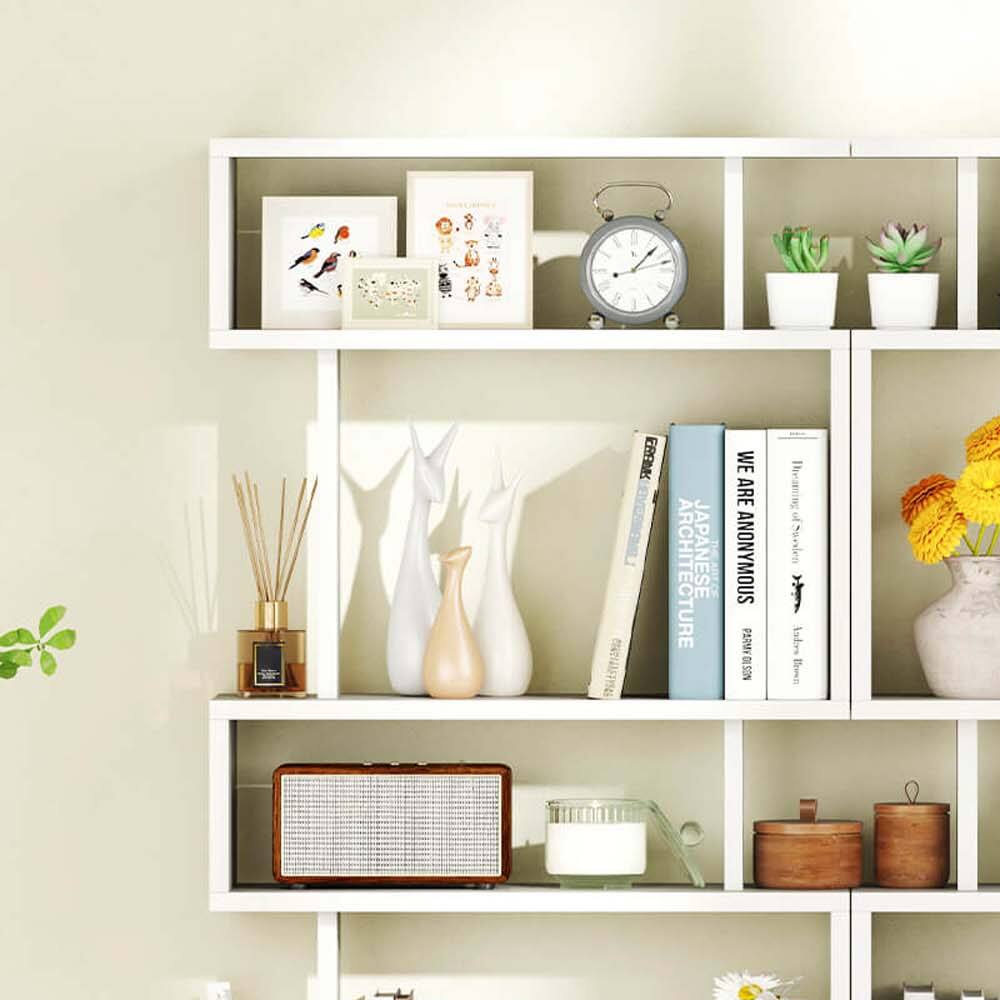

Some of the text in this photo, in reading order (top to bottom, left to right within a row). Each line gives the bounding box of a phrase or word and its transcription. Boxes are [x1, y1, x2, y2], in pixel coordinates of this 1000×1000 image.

[694, 499, 709, 599] JAPANESE
[737, 451, 754, 604] WE ARE ANONYMOUS
[790, 460, 803, 564] Dreaming of Sweden
[678, 498, 694, 648] ARCHITECTURE
[742, 628, 752, 681] PARMY OLSON
